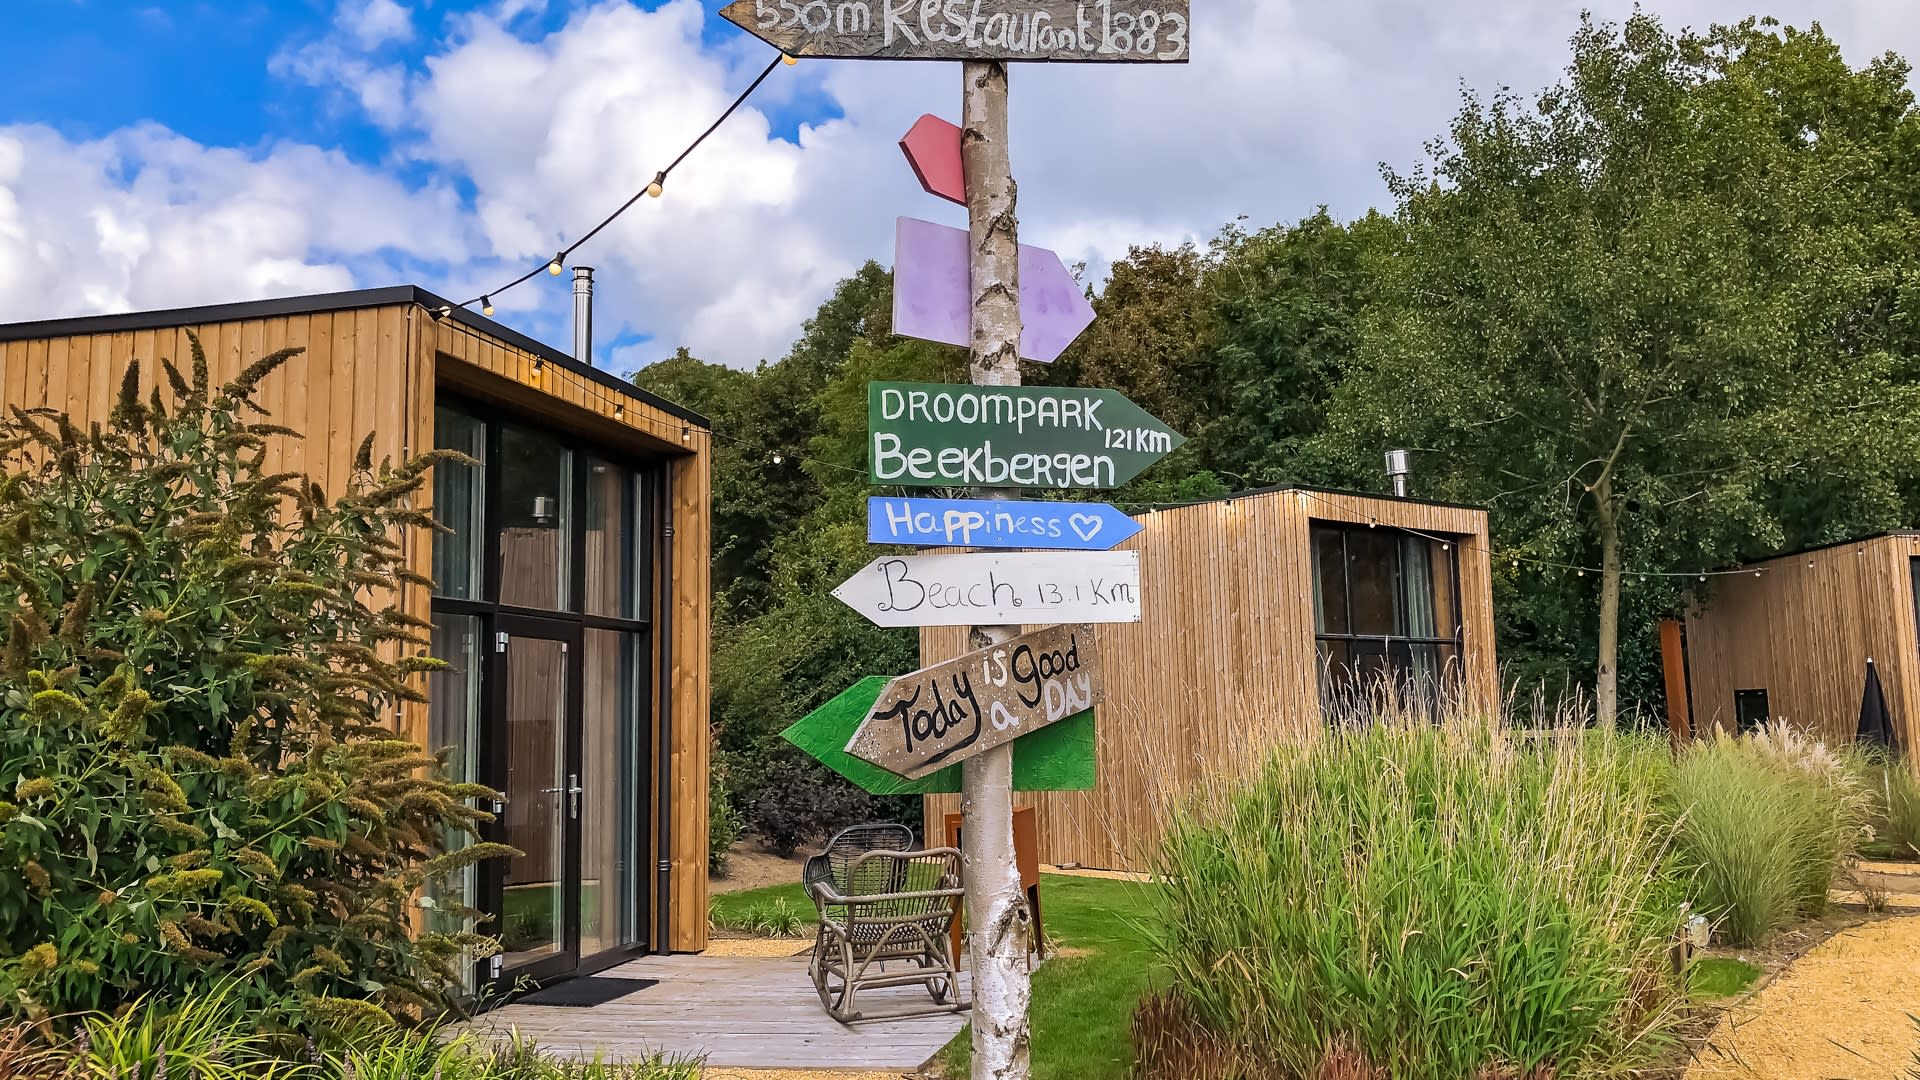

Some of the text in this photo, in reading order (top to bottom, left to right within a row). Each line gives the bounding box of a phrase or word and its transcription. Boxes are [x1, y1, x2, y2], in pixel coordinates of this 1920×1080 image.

[1097, 0, 1187, 60] 1883
[874, 432, 1115, 487] Beekbergen
[1105, 428, 1132, 450] 121
[885, 502, 1062, 544] Happiness
[877, 560, 1023, 611] Beach
[1038, 583, 1080, 604] 13.1
[873, 672, 981, 773] Today
[983, 649, 1008, 687] is
[990, 671, 1091, 730] a DAY
